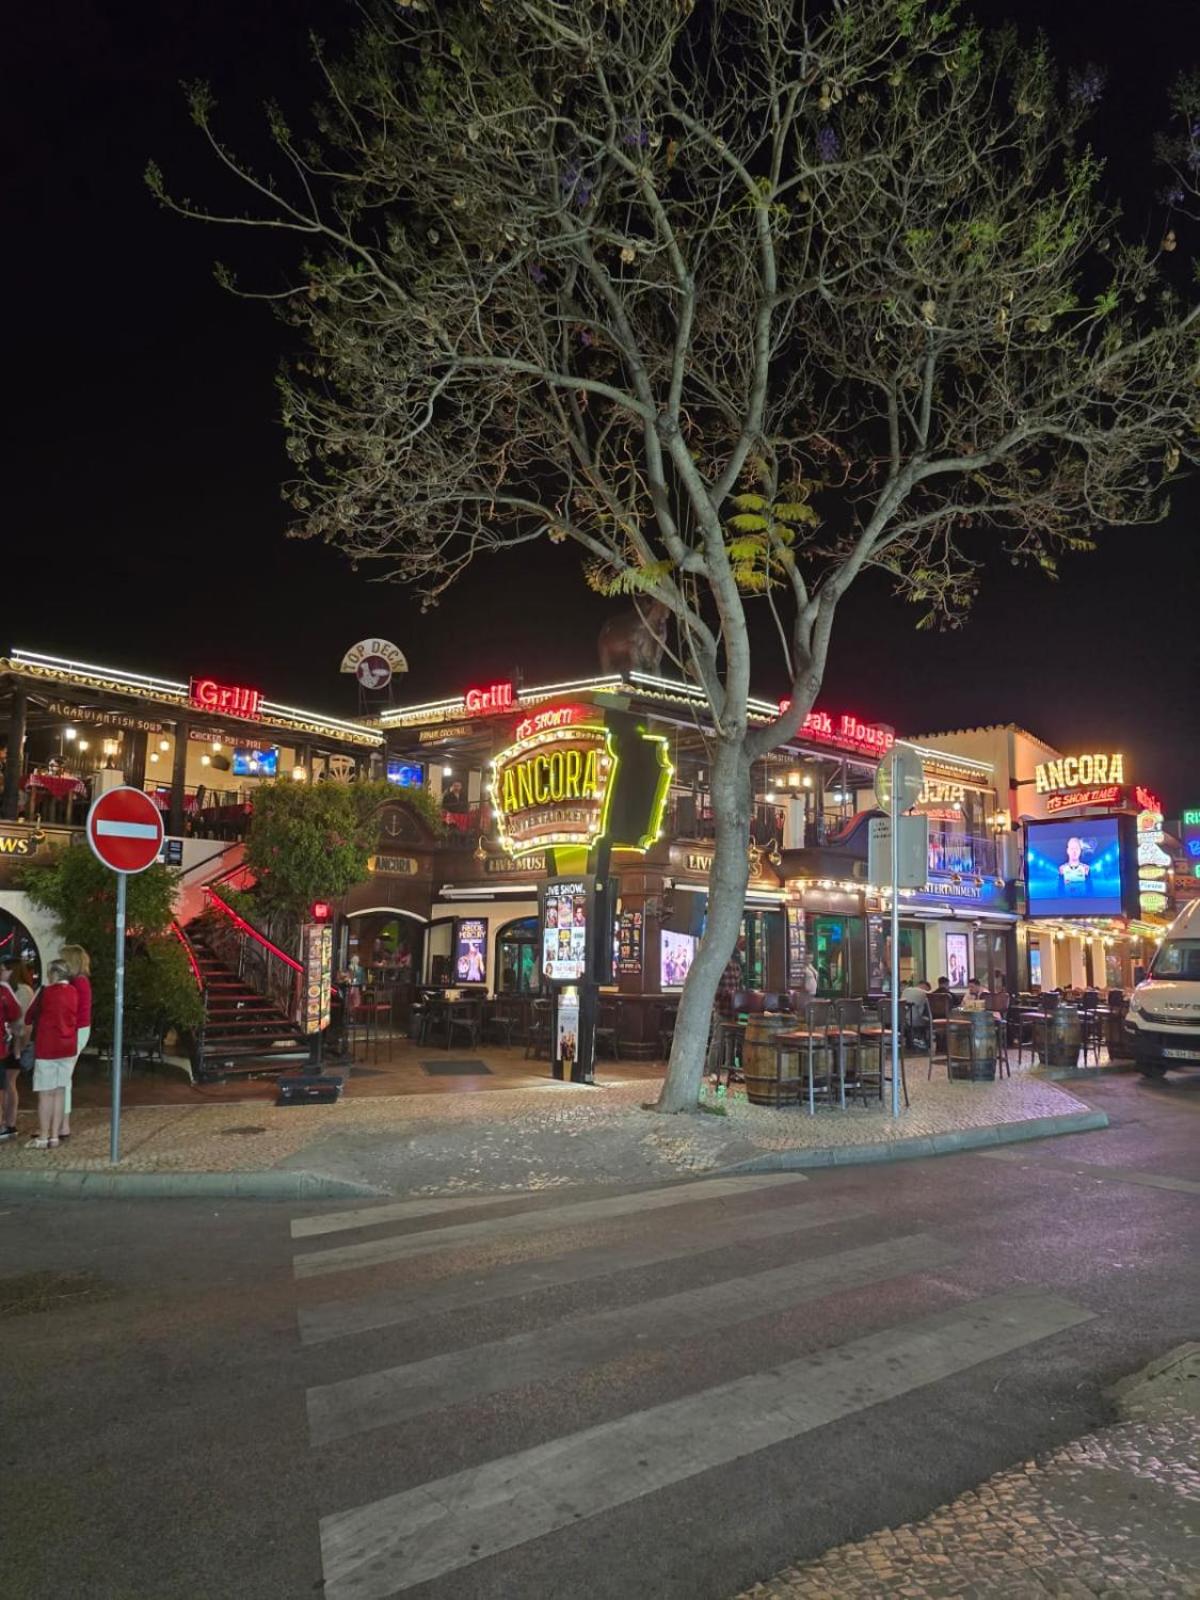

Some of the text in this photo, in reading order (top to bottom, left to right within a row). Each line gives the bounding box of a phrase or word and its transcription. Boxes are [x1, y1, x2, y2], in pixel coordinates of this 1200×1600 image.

[343, 641, 405, 671] TOP DECK
[199, 681, 258, 713] Grill
[466, 684, 512, 710] Grill
[112, 715, 135, 727] FISH
[841, 715, 893, 748] House
[503, 750, 599, 814] ANCORA
[1035, 754, 1124, 793] ANCORA
[1062, 791, 1091, 805] SHOW
[515, 856, 546, 871] MUSI
[688, 855, 712, 871] LIV
